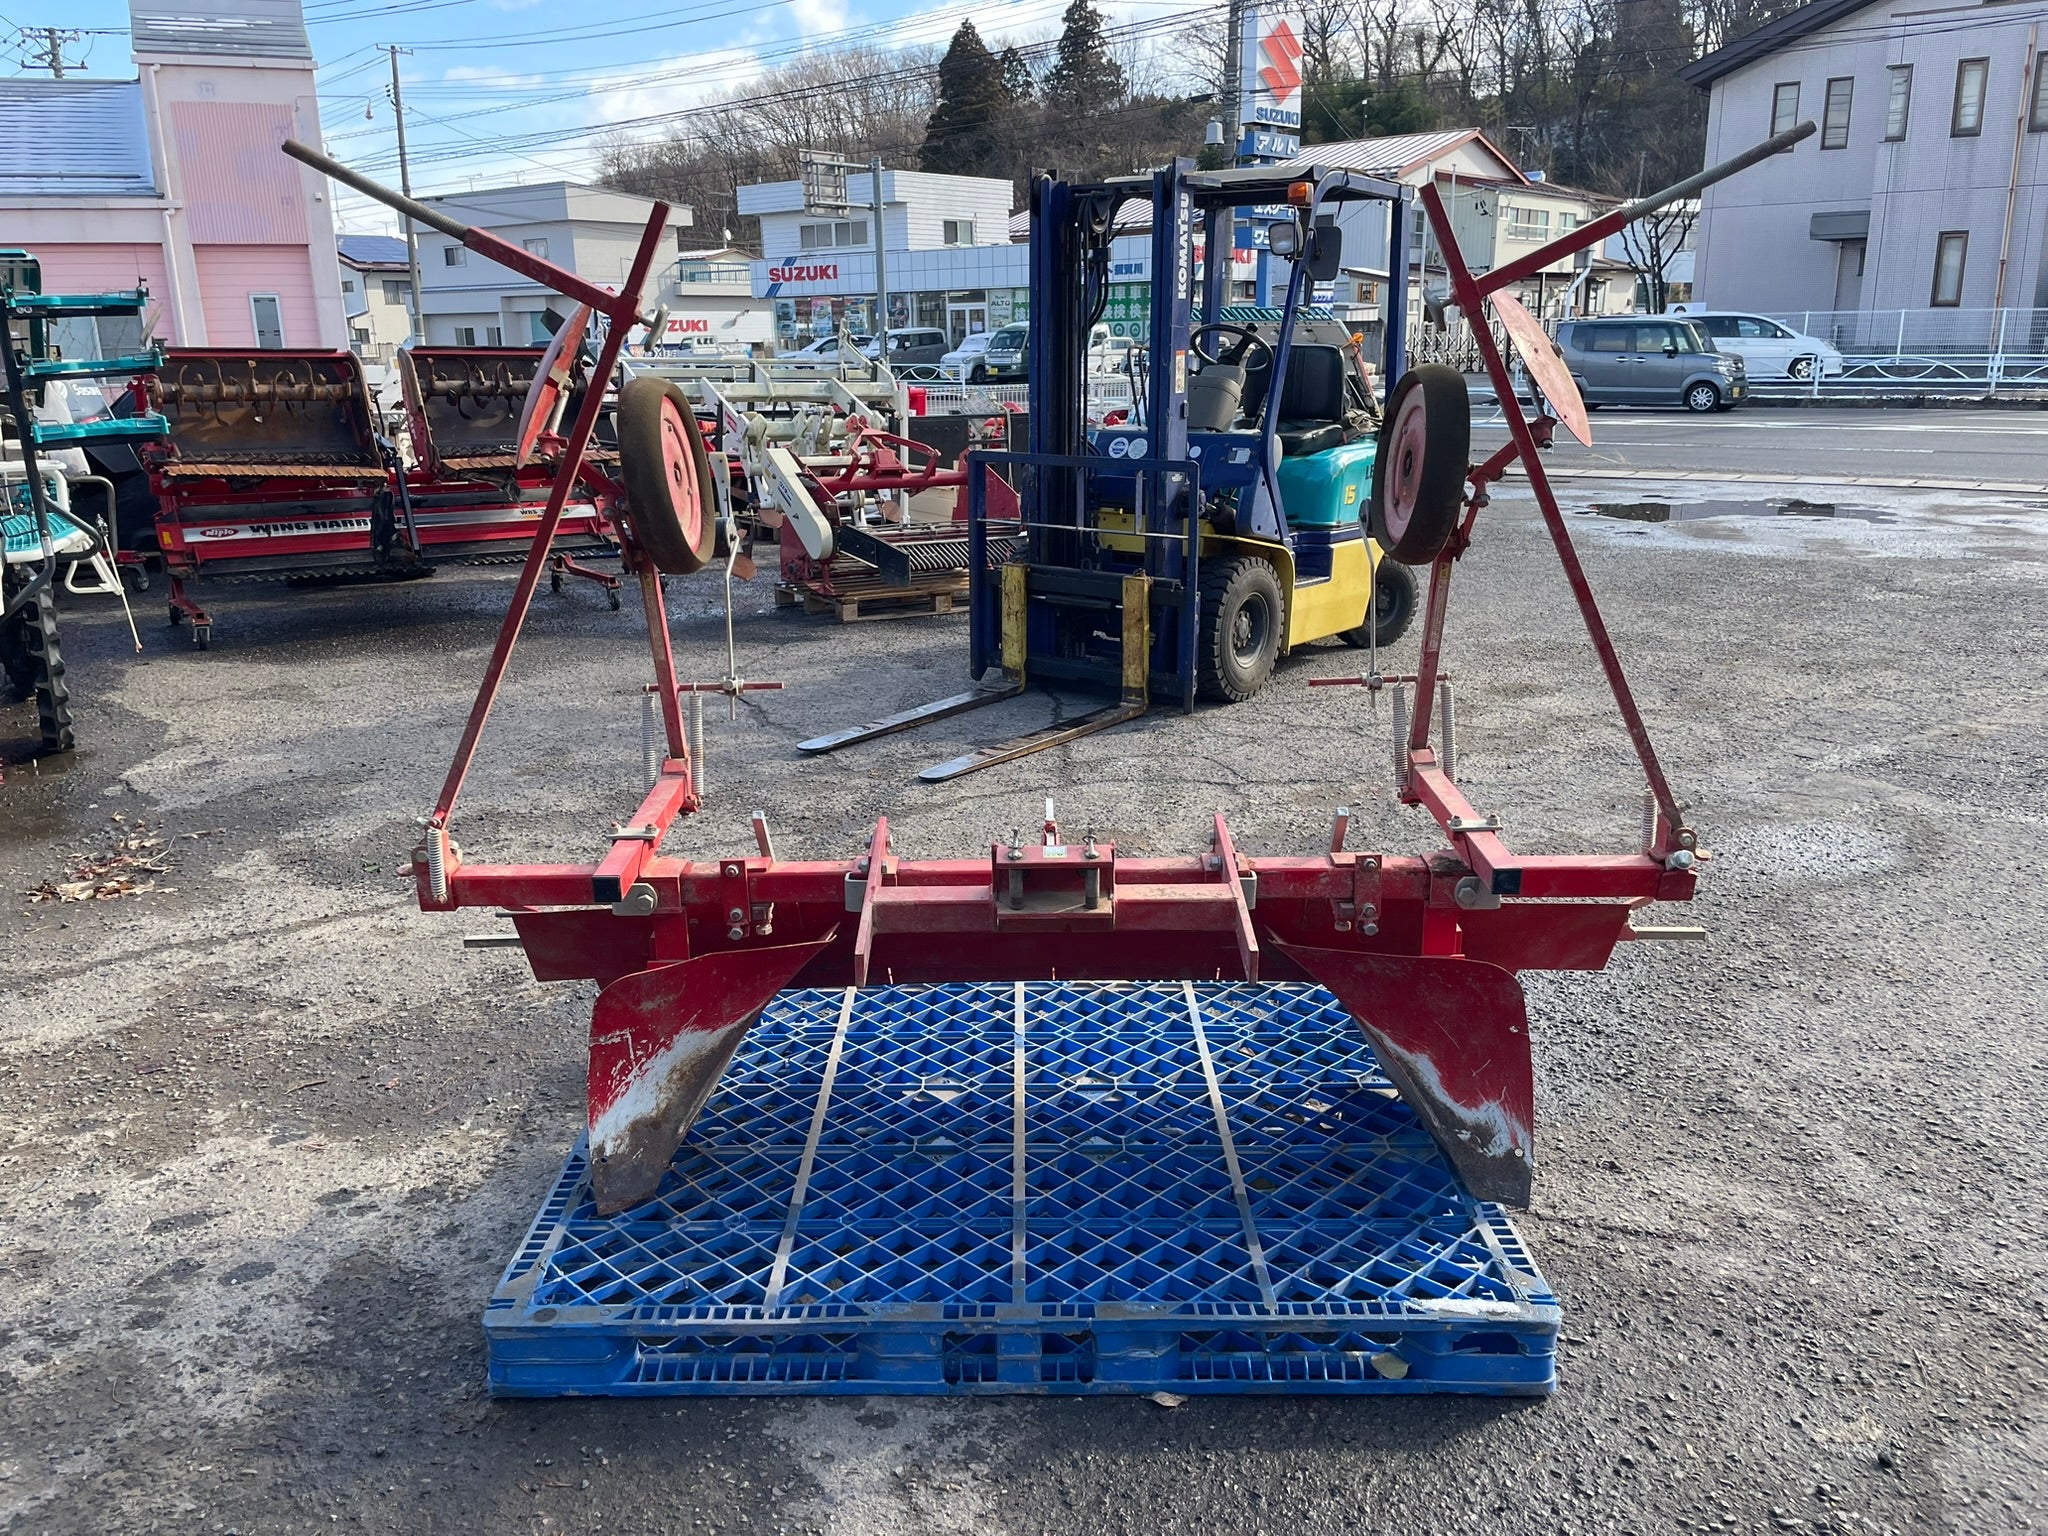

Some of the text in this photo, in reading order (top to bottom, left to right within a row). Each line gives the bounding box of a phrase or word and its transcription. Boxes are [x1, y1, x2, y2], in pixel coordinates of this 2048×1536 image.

[1256, 107, 1300, 126] SUZUKI
[1257, 135, 1298, 155] アルト
[1177, 192, 1190, 300] KOMATSU
[769, 264, 838, 283] SUZUKI
[1344, 485, 1357, 506] 15
[204, 517, 372, 539] Niplo WING HARR
